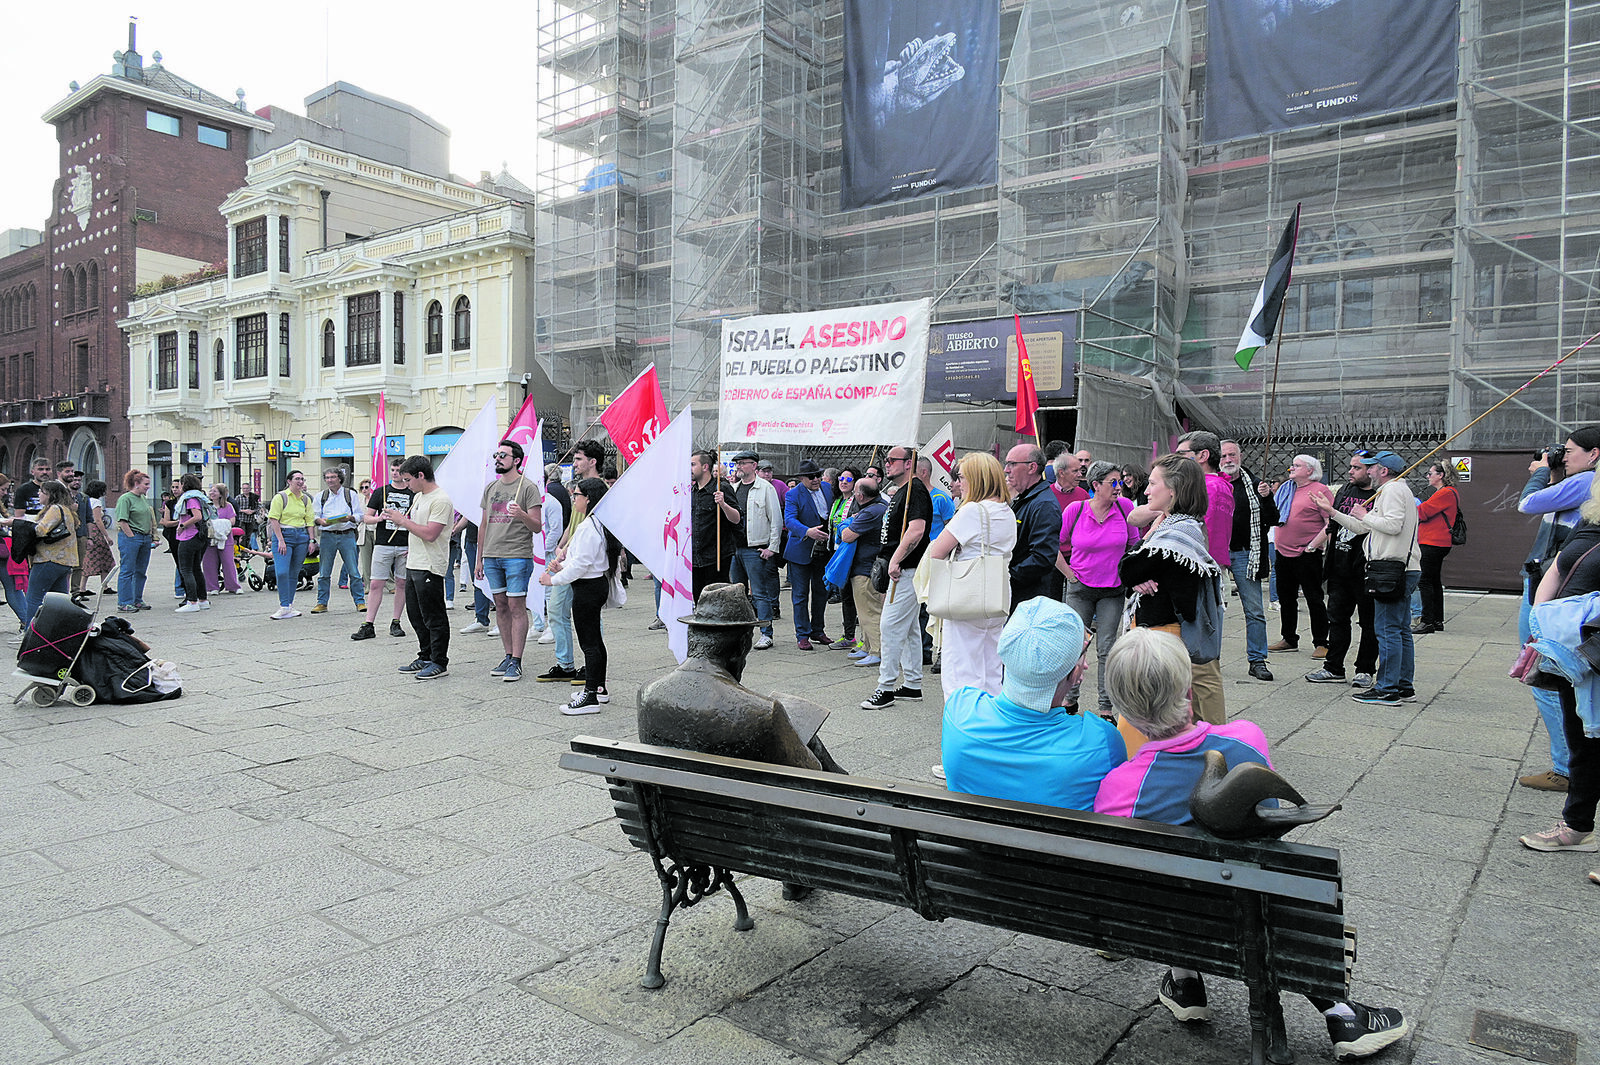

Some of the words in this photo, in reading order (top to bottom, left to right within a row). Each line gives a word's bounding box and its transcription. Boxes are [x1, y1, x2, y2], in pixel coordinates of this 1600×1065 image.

[1316, 94, 1358, 109] FUNDOS
[910, 178, 937, 189] FUNDOS
[727, 327, 794, 352] ISRAEL
[799, 316, 907, 349] ASESINO
[947, 331, 974, 339] museo
[946, 336, 999, 352] ABIERTO
[725, 361, 747, 377] DEL
[749, 358, 807, 376] PUEBLO
[810, 351, 906, 375] PALESTINO
[772, 388, 783, 400] de
[786, 384, 832, 401] ESPAÑA
[834, 382, 898, 400] CÓMPLICE
[758, 420, 780, 428] Partido
[780, 420, 815, 428] Comunista
